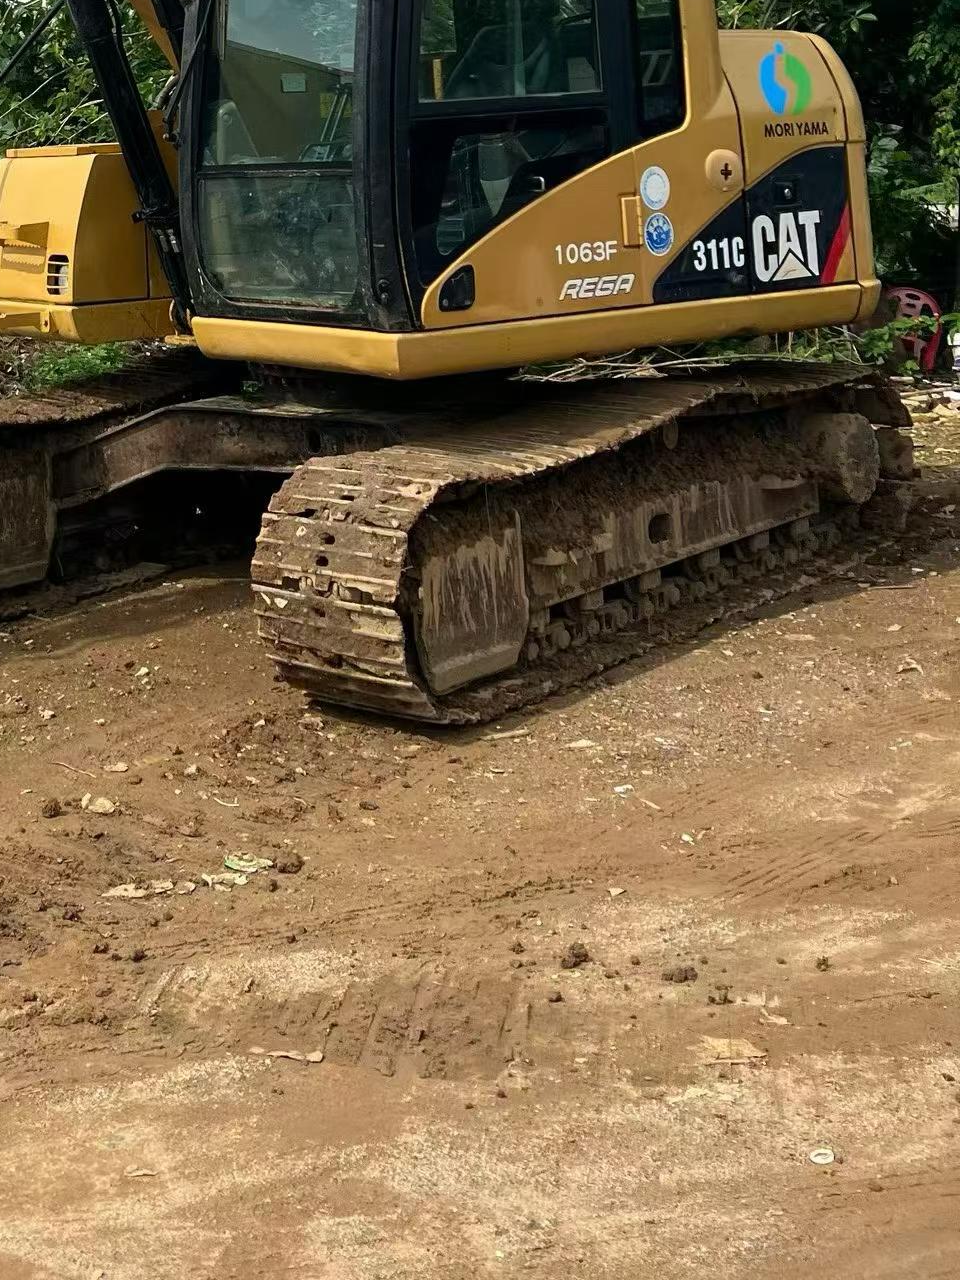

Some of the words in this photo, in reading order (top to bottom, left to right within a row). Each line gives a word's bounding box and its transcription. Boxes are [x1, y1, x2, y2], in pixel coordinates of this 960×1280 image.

[555, 240, 618, 265] 1063F
[693, 236, 745, 272] 311C
[752, 210, 820, 282] CAT
[559, 273, 635, 301] REGA
